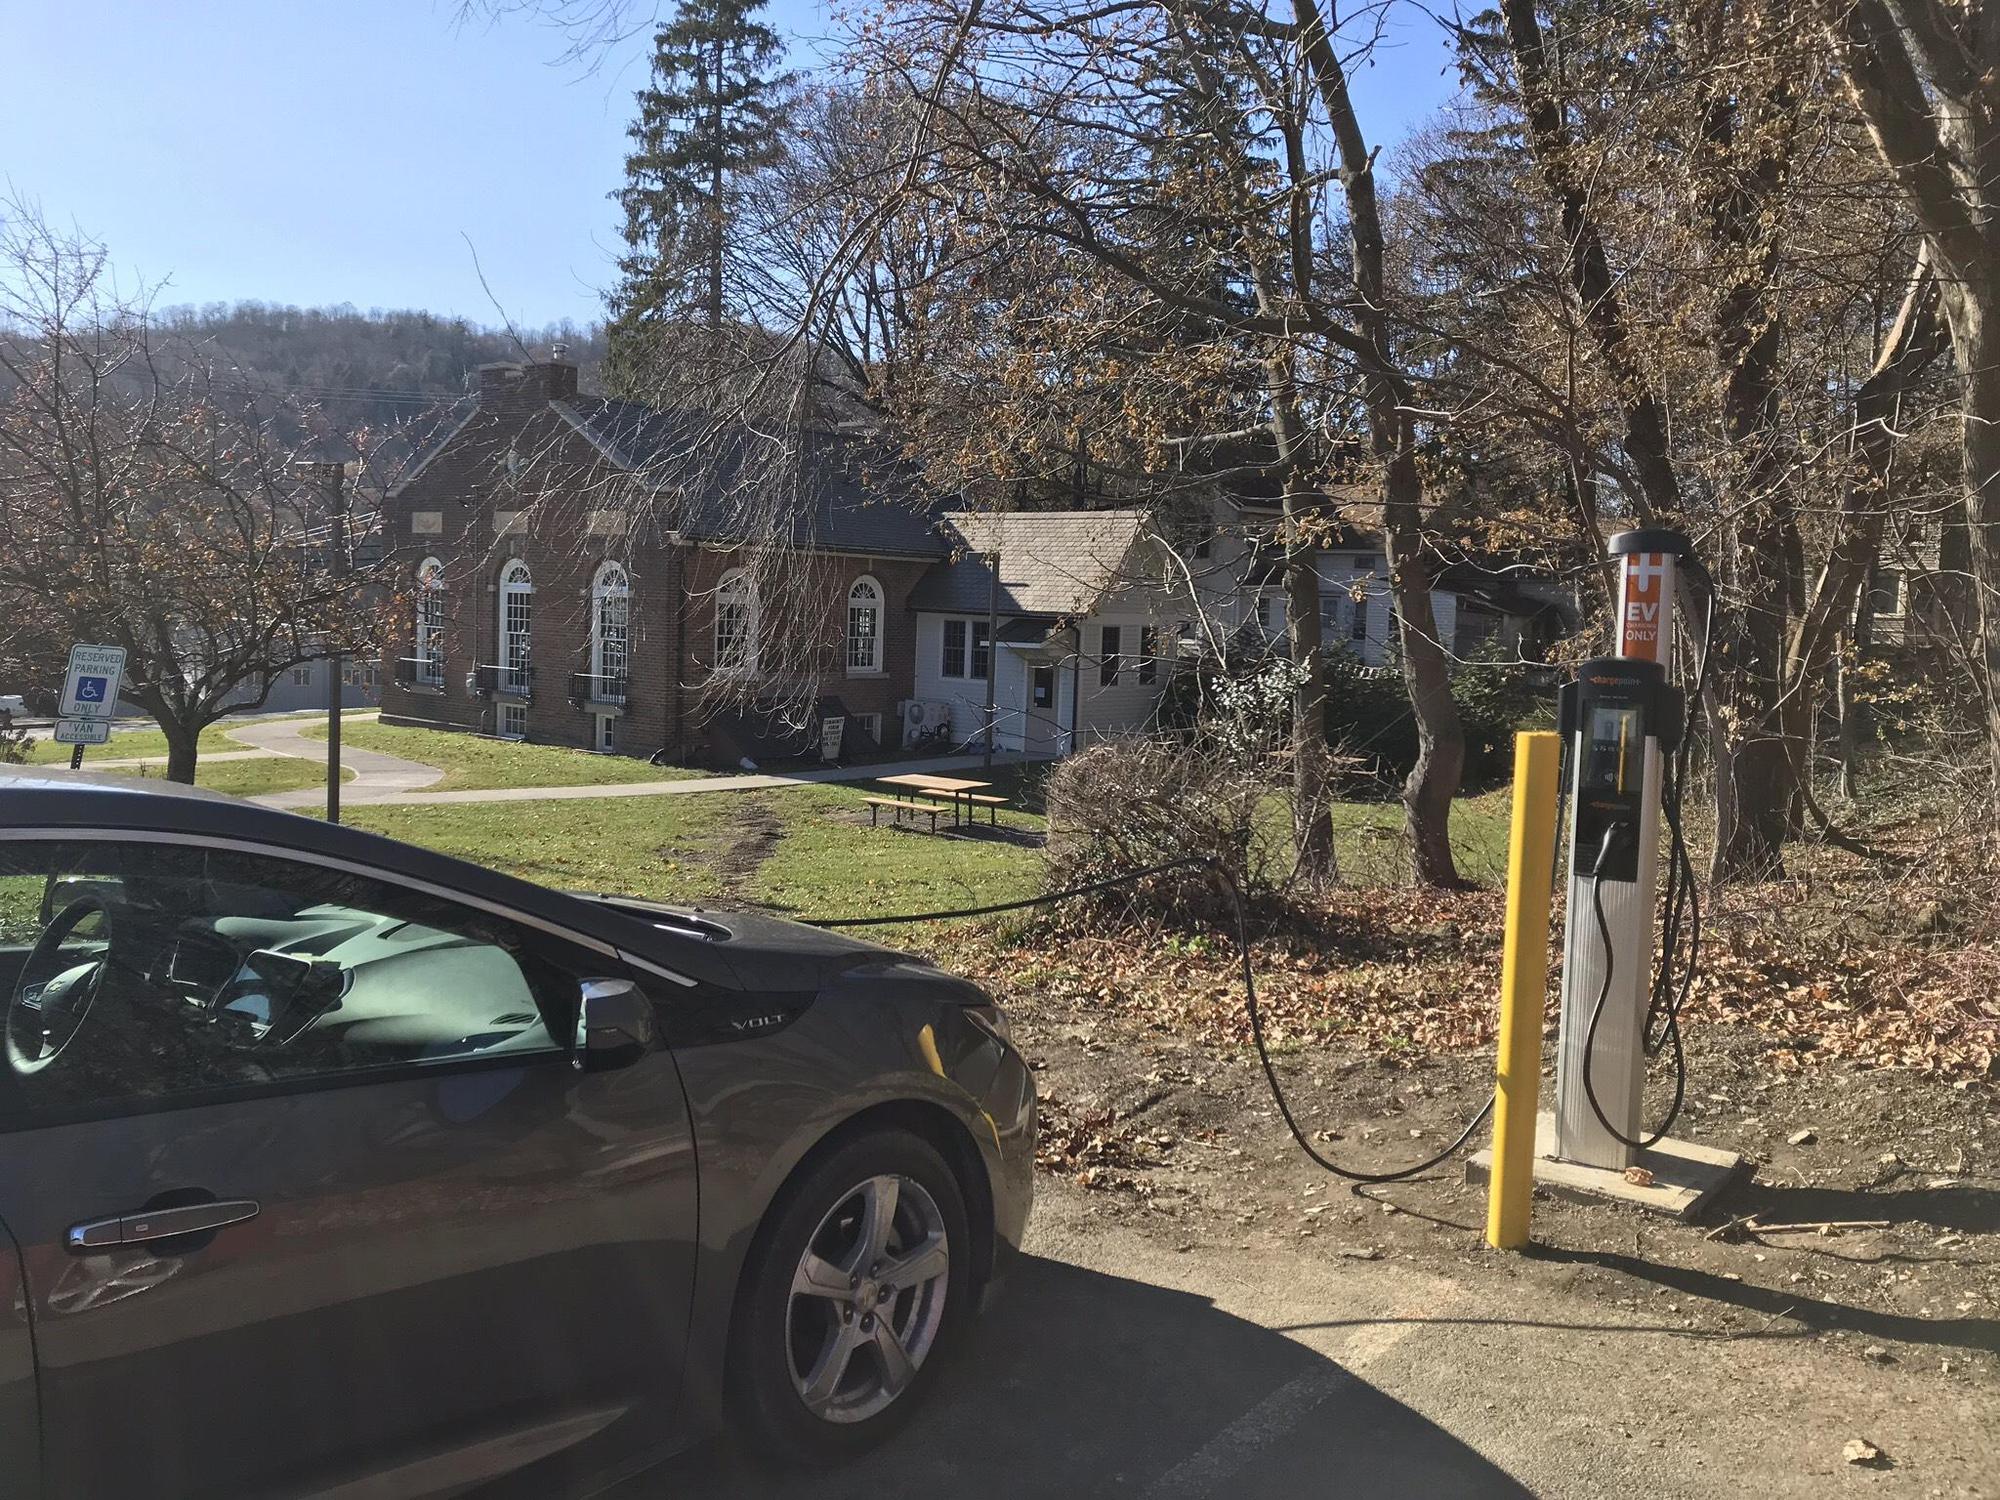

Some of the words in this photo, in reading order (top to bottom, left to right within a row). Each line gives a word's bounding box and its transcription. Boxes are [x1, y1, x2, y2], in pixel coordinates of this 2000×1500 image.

[1627, 602, 1658, 621] EV
[1625, 630, 1657, 641] ONLY
[74, 651, 121, 663] RESERVED
[74, 663, 116, 675] PARKING
[74, 703, 101, 713] ONLY
[74, 723, 94, 733] VAN
[731, 1014, 785, 1030] VOLT
